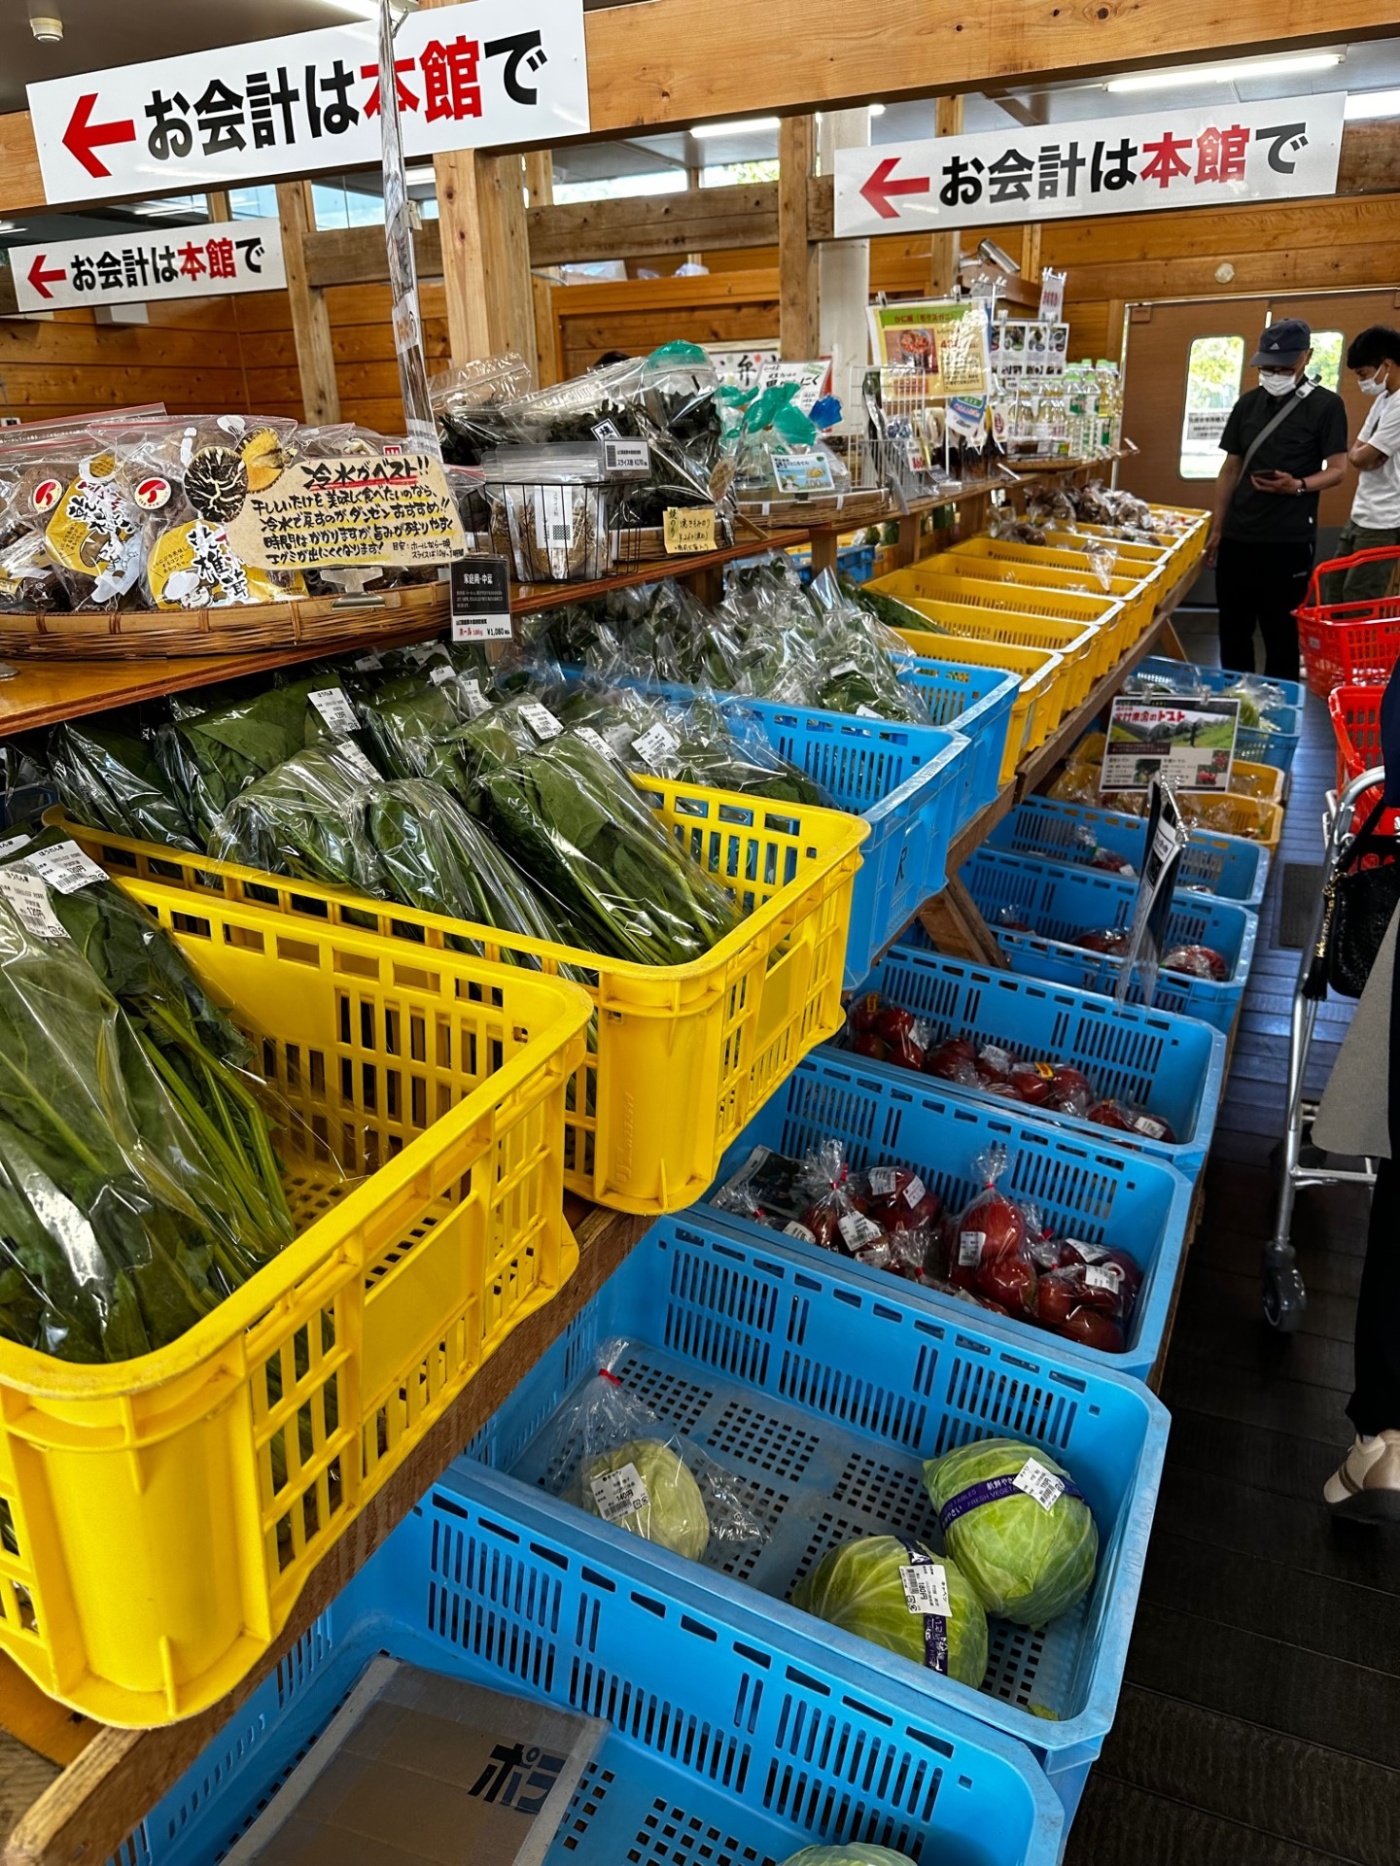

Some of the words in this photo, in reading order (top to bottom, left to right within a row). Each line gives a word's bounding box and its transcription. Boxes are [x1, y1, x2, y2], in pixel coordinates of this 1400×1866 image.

[144, 29, 547, 161] お会計は本館で
[939, 121, 1309, 208] お会計は本館で
[71, 236, 266, 292] お会計は本館で
